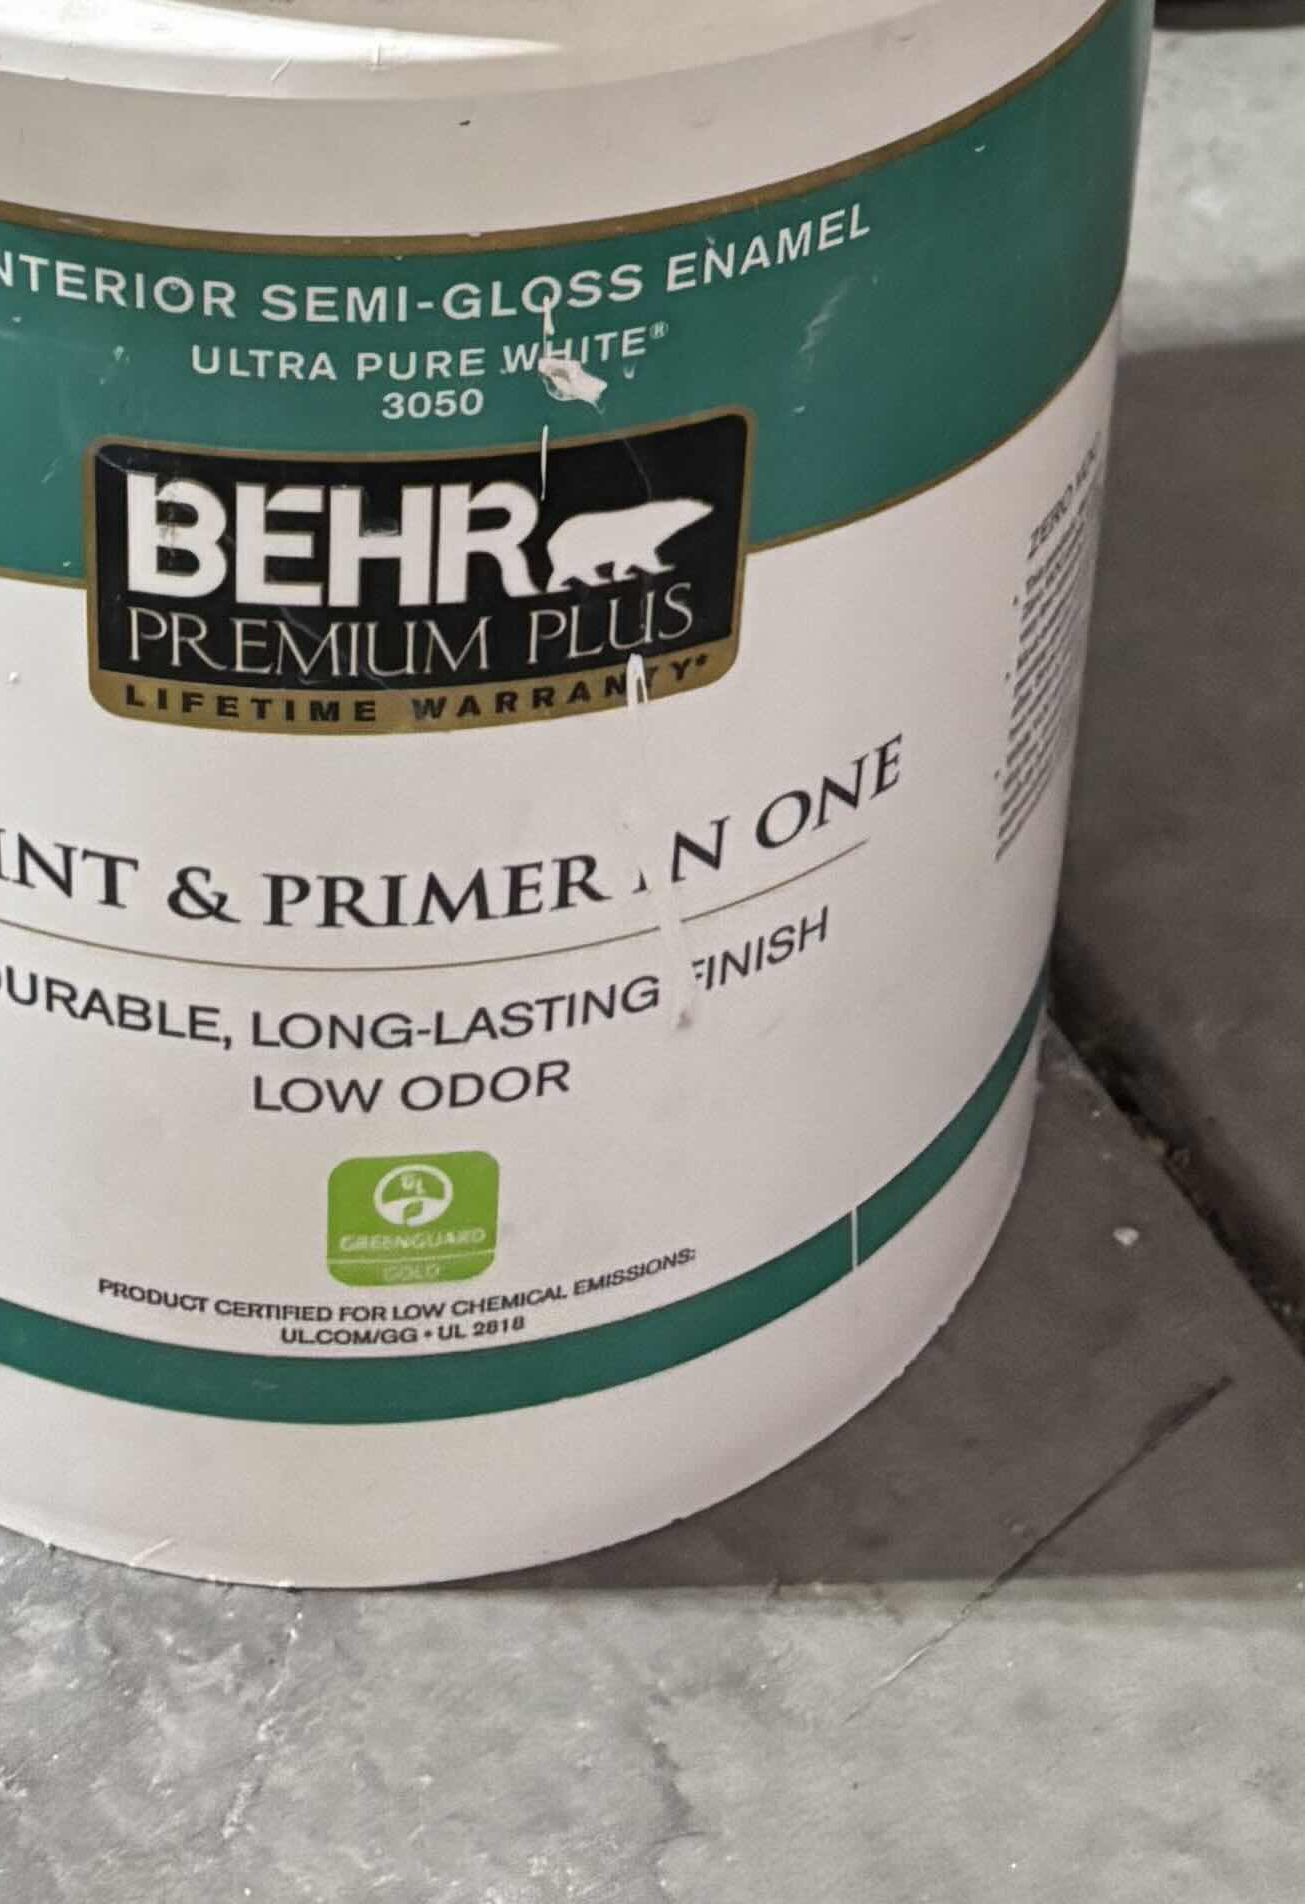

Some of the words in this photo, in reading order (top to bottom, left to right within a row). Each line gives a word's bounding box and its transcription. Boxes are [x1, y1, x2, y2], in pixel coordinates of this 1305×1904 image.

[260, 267, 643, 324] SEMI-GLOSS
[666, 202, 871, 293] ENAMEL
[191, 345, 338, 382] ULTRA
[356, 345, 487, 382] PURE
[381, 389, 484, 421] 3050
[126, 472, 545, 608] BEHR
[129, 601, 491, 679] PREMIUM
[527, 581, 695, 667] PLUS
[127, 684, 376, 723] LIFETIME
[168, 866, 241, 924] &
[263, 852, 612, 928] PRIMER
[755, 733, 903, 850] ONE
[252, 975, 660, 1051] LONG-LASTING
[253, 1076, 381, 1114] LOW
[399, 1059, 570, 1113] ODOR
[340, 1228, 487, 1252] GREENGUARD
[98, 1278, 209, 1313] PRODUCT
[215, 1299, 333, 1322] CERTIFIED
[339, 1304, 387, 1323] FOR
[392, 1301, 447, 1321] LOW
[451, 1283, 568, 1316] CHEMICAL
[573, 1246, 696, 1297] EMISSIONS:
[438, 1323, 467, 1340] UL
